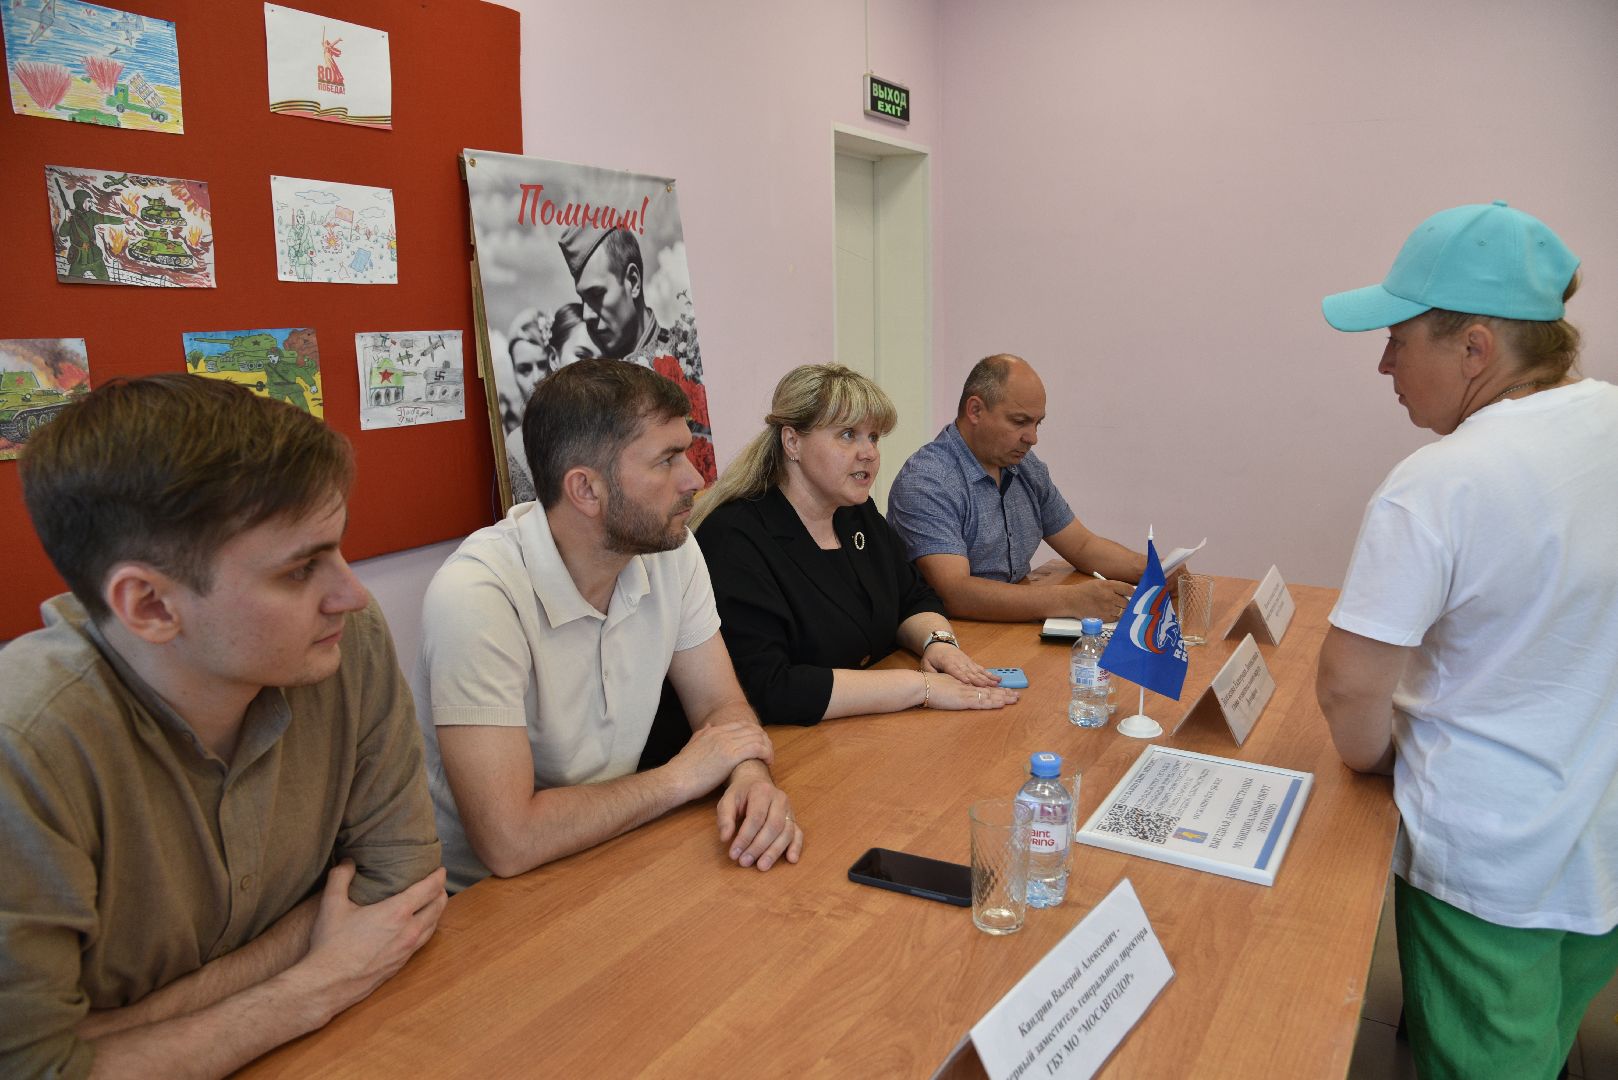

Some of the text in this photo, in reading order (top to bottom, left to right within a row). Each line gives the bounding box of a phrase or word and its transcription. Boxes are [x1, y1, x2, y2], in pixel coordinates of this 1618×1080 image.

[318, 82, 346, 95] ПОБЕДА!
[872, 83, 907, 109] ВЫХОД
[877, 100, 903, 117] EXIT
[518, 183, 650, 235] Помним!
[1006, 926, 1149, 1080] ервый заместитель генерального директора
[1018, 999, 1053, 1037] Кандрин
[1051, 967, 1081, 1003] Валерий
[1046, 1048, 1063, 1075] ГБУ
[1063, 1033, 1079, 1056] МО
